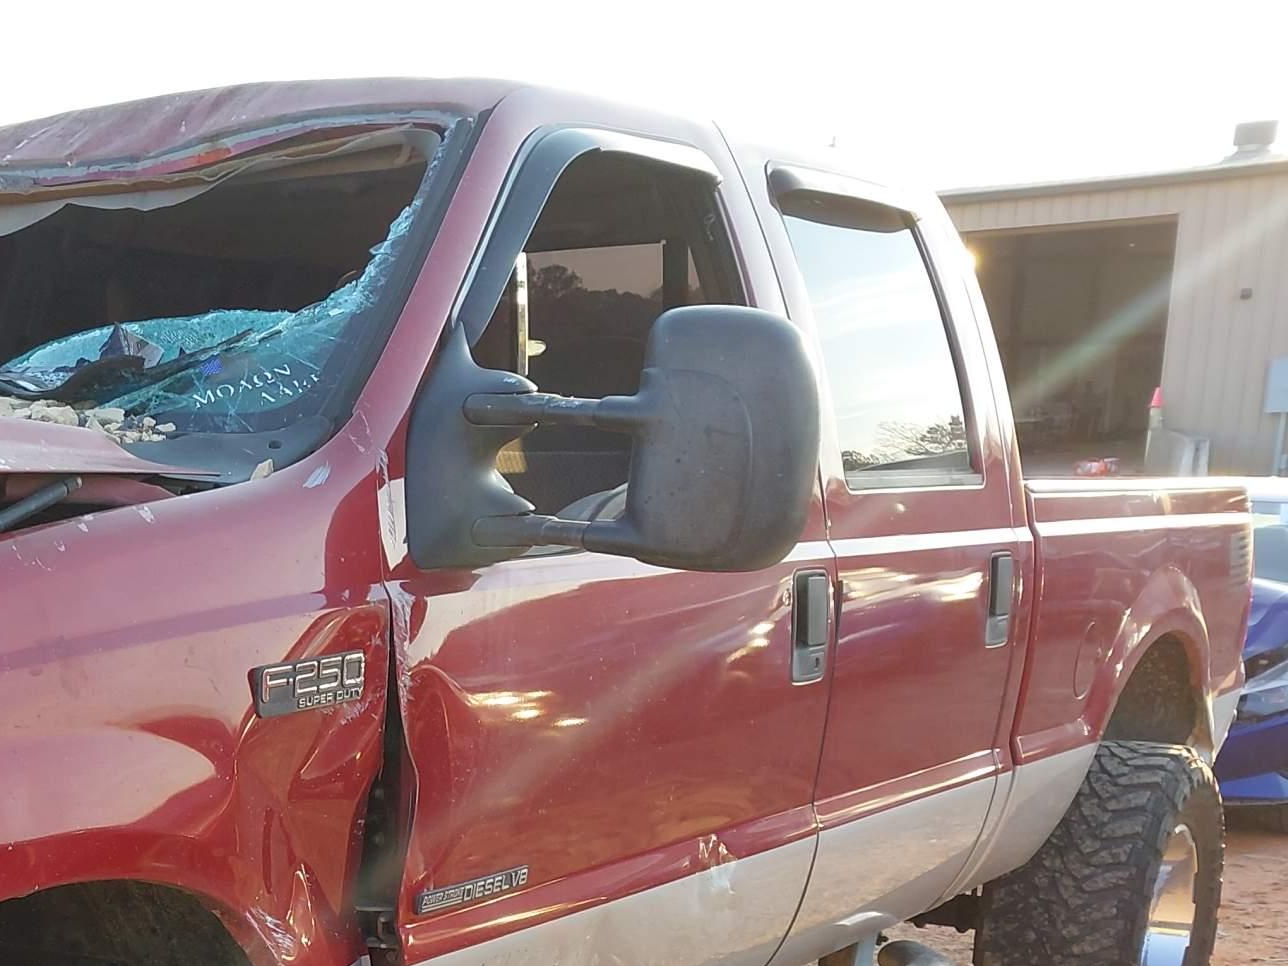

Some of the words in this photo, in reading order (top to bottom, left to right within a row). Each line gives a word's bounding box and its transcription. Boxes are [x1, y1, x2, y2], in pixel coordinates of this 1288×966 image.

[298, 693, 334, 708] SUPER
[335, 688, 364, 702] DUTY
[464, 876, 509, 901] DIESEL
[511, 868, 529, 887] V8
